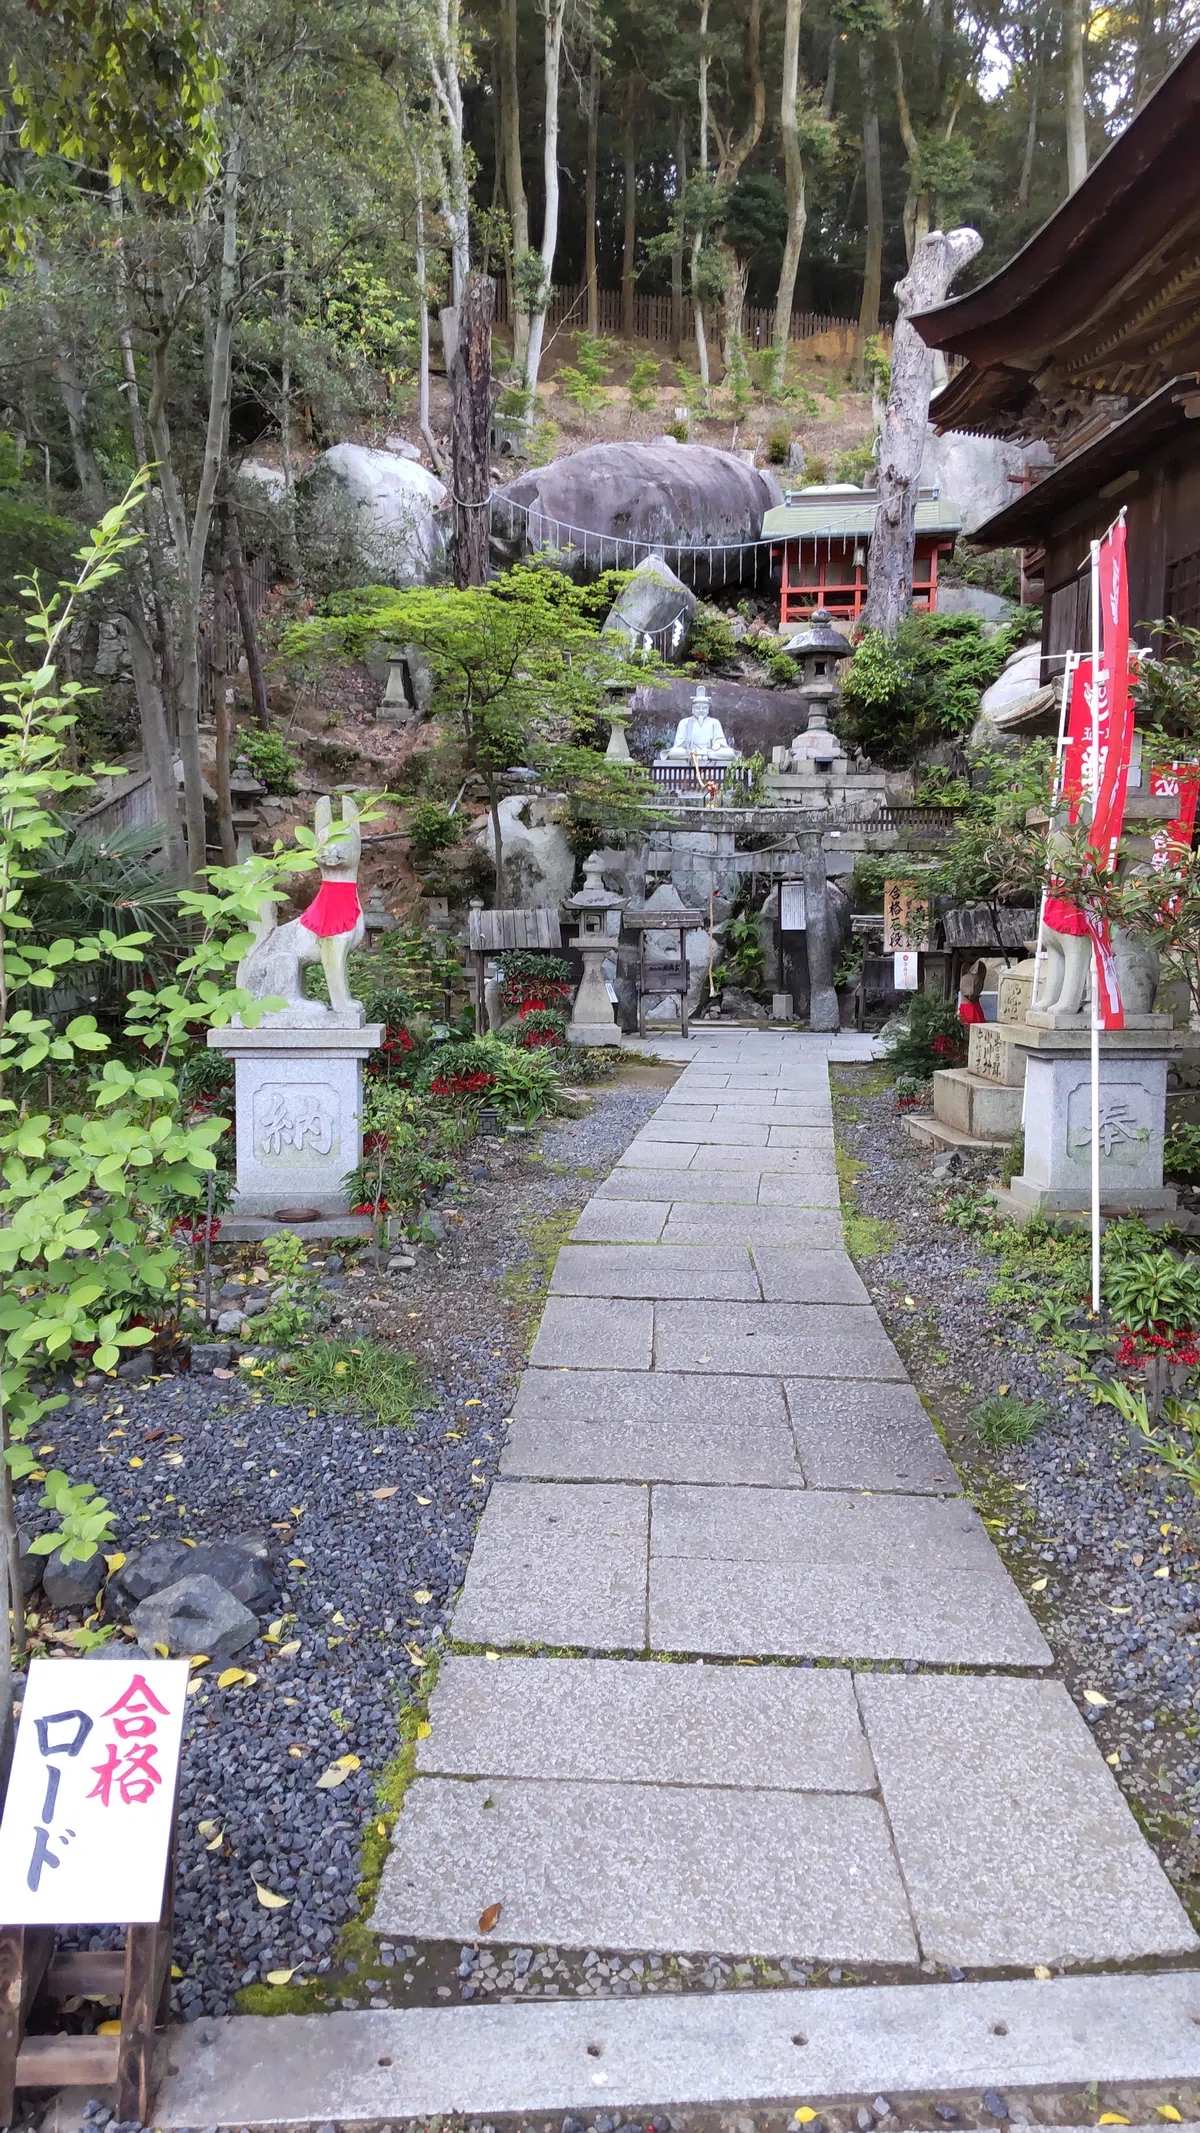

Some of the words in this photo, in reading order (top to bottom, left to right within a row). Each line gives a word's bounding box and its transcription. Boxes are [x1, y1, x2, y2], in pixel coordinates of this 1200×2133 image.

[261, 1091, 335, 1156] 納
[26, 1708, 94, 1893] ロード
[85, 1673, 172, 1808] 合格
